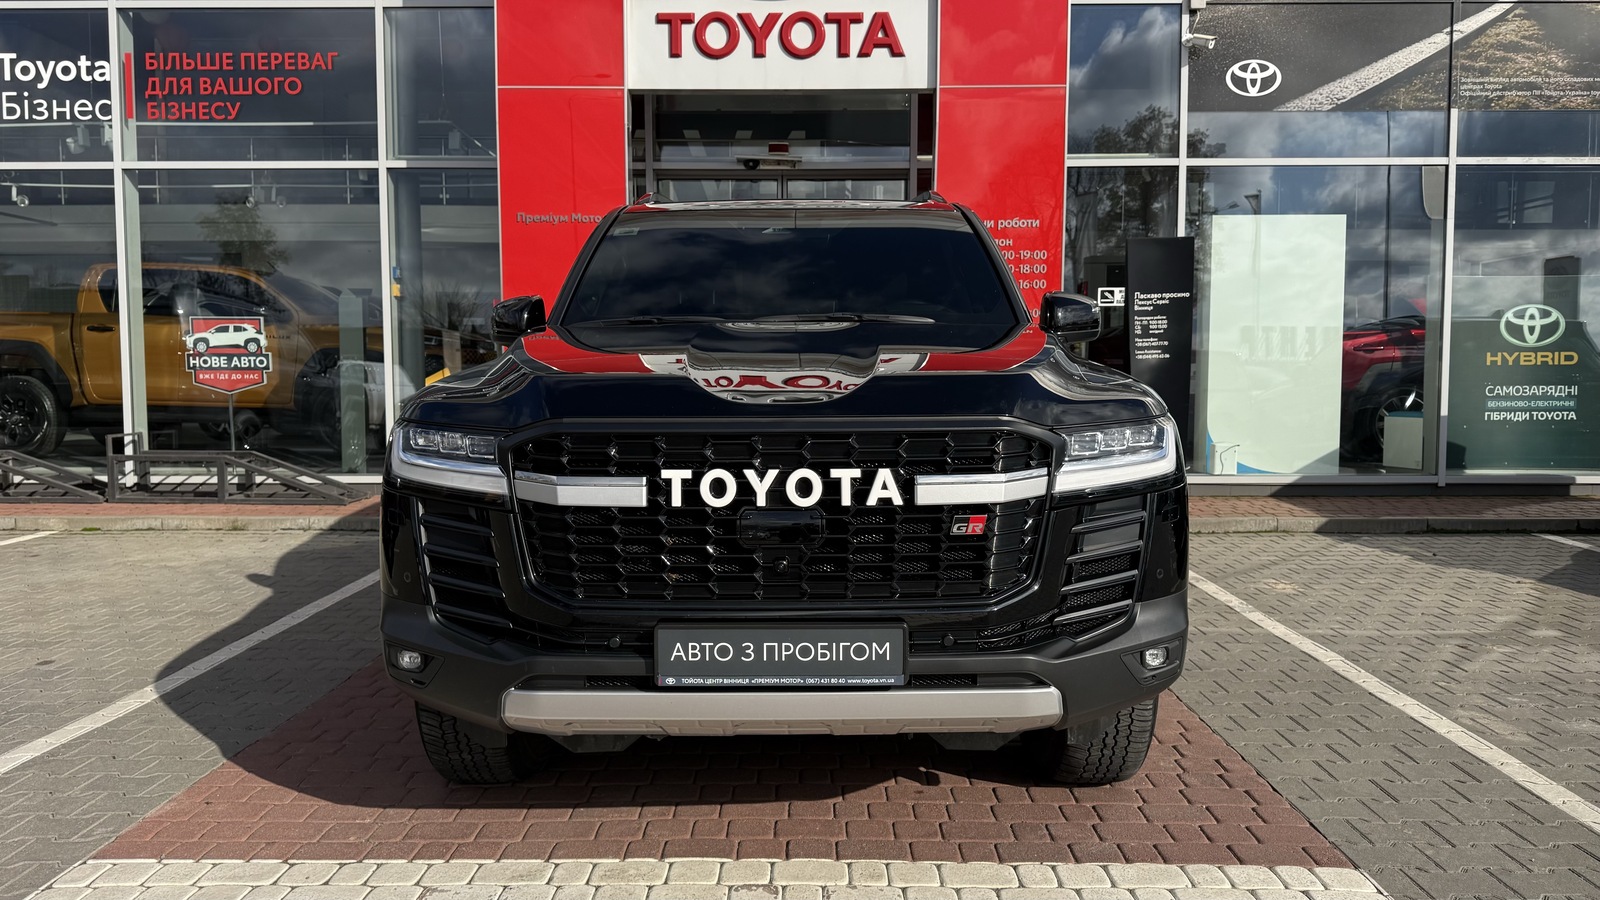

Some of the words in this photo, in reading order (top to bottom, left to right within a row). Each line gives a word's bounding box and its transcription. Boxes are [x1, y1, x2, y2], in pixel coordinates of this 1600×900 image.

[655, 11, 906, 59] TOYOTA
[145, 52, 234, 71] БІЛЬШЕ
[240, 52, 339, 71] ПЕРЕВАГ
[0, 52, 110, 89] Toyota
[145, 77, 192, 99] ДЛЯ
[200, 77, 303, 95] ВАШОГО
[2, 91, 112, 120] Бізнес
[146, 102, 241, 120] БІЗНЕСУ
[516, 212, 568, 225] Преміум
[571, 213, 602, 223] Мото
[998, 216, 1040, 231] роботи
[1018, 279, 1047, 289] 16:00
[189, 356, 228, 368] НОВЕ
[230, 356, 267, 368] АВТО
[1486, 351, 1579, 366] HYBRID
[217, 372, 229, 380] ЇДЕ
[1485, 385, 1578, 398] САМОЗАРЯДНІ
[1487, 400, 1575, 408] БЕНЗИНОВО-ЕЛЕКТРИЧНІ
[1484, 411, 1530, 422] ГІБРИДИ
[1531, 411, 1577, 421] TOYOTA
[660, 468, 904, 508] TOYOTA
[953, 522, 984, 533] GR
[670, 642, 734, 662] АВТО
[741, 642, 755, 662] З
[763, 642, 890, 662] ПРОБІГОМ
